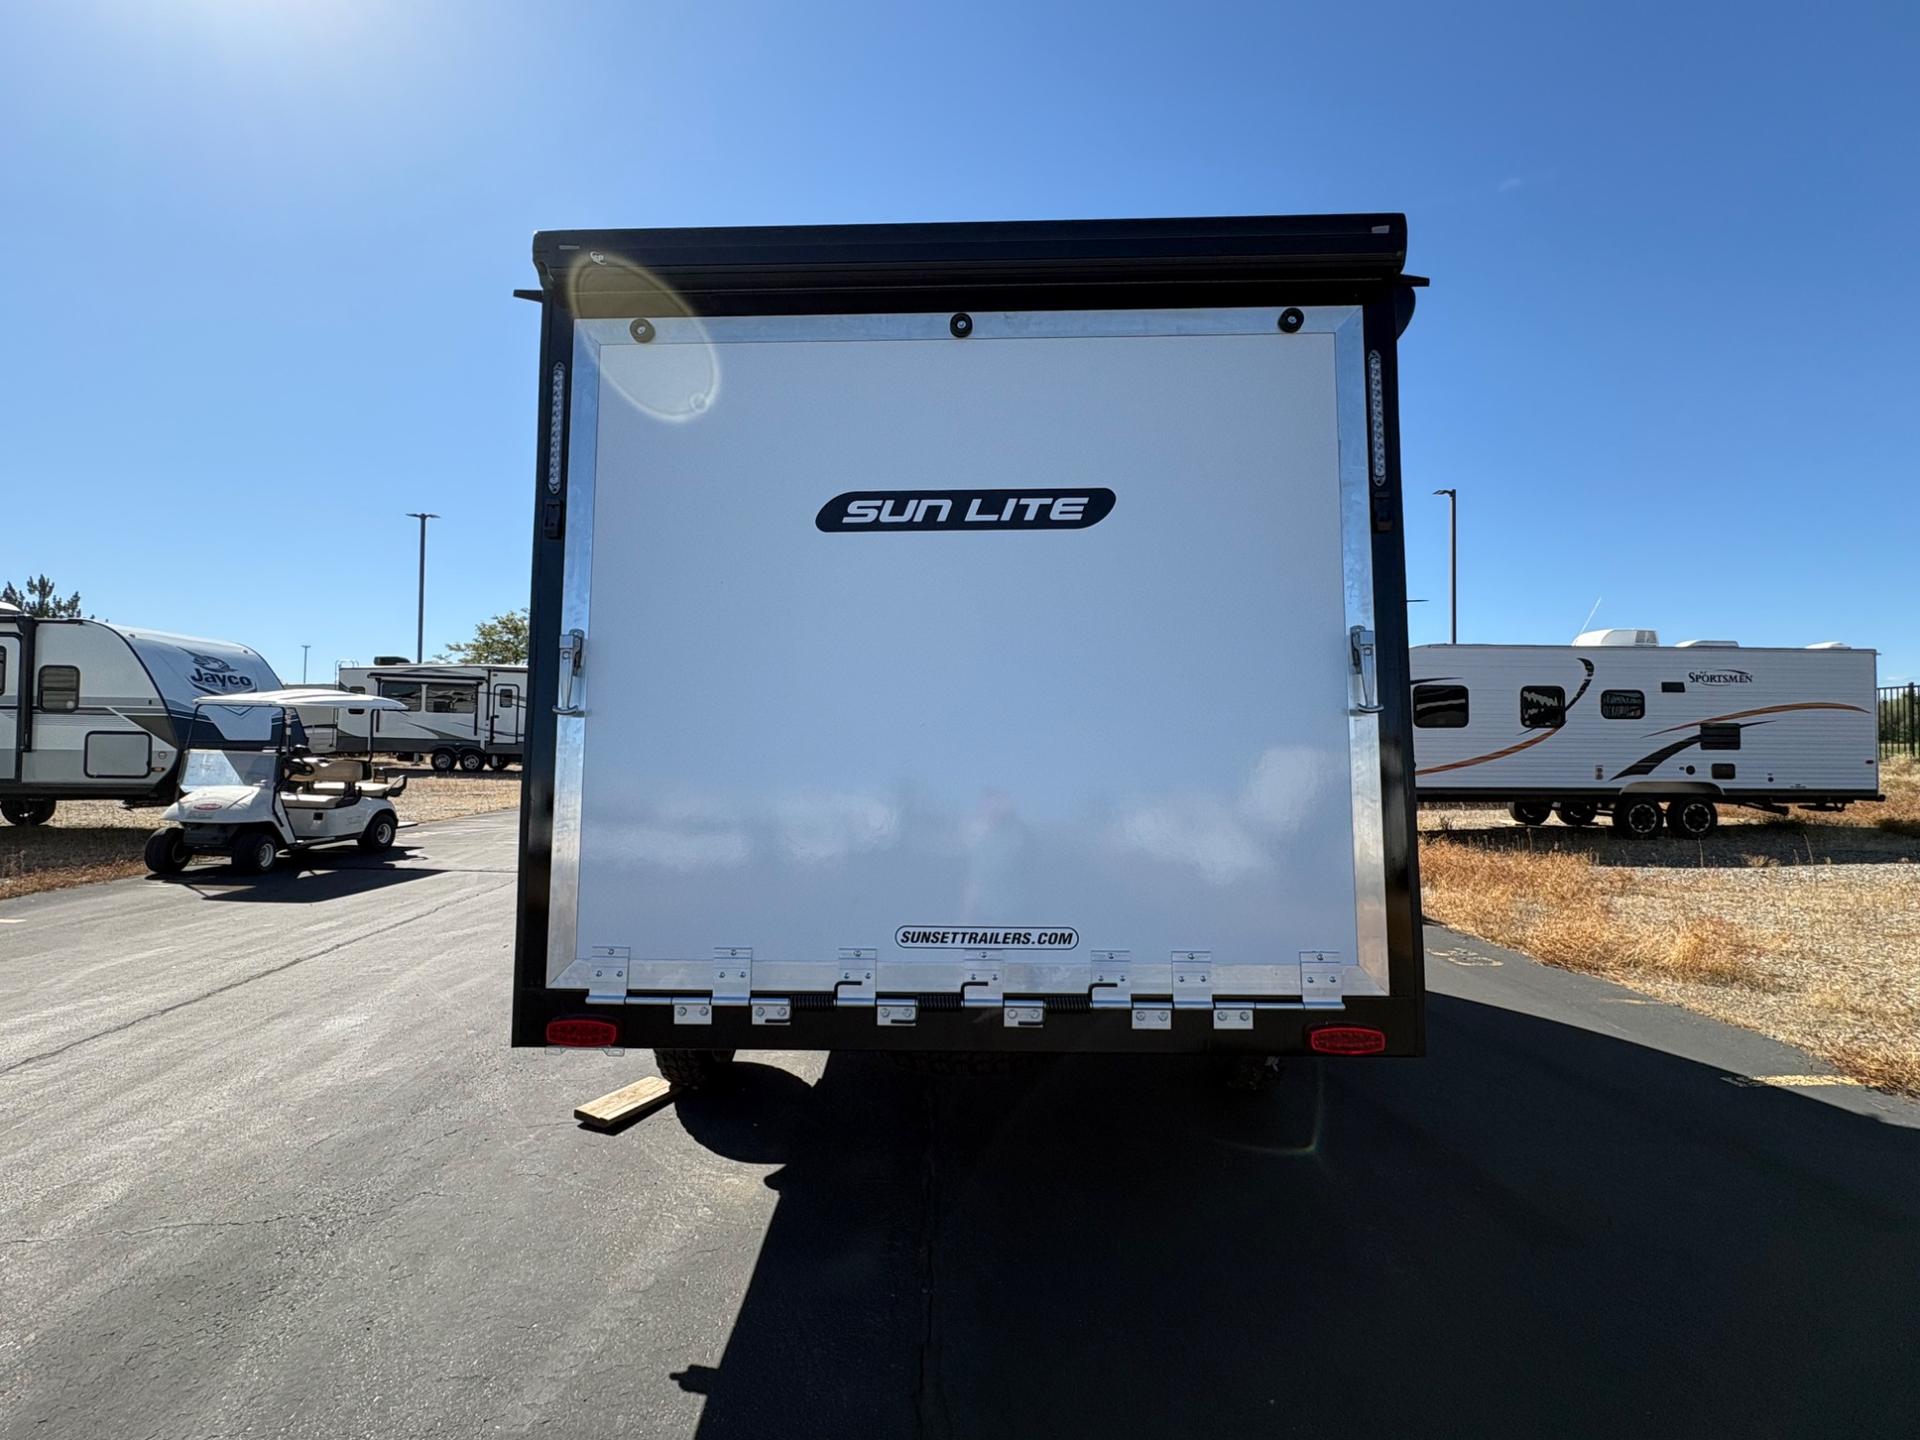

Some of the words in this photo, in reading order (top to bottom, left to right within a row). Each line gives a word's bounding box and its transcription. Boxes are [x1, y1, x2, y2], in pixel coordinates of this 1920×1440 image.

[842, 499, 953, 524] SUN
[964, 496, 1090, 522] LITE
[190, 668, 252, 687] Jayco
[1688, 671, 1753, 684] SPORTSMEN
[900, 930, 1073, 945] SUNSETTRAILERS.COM
